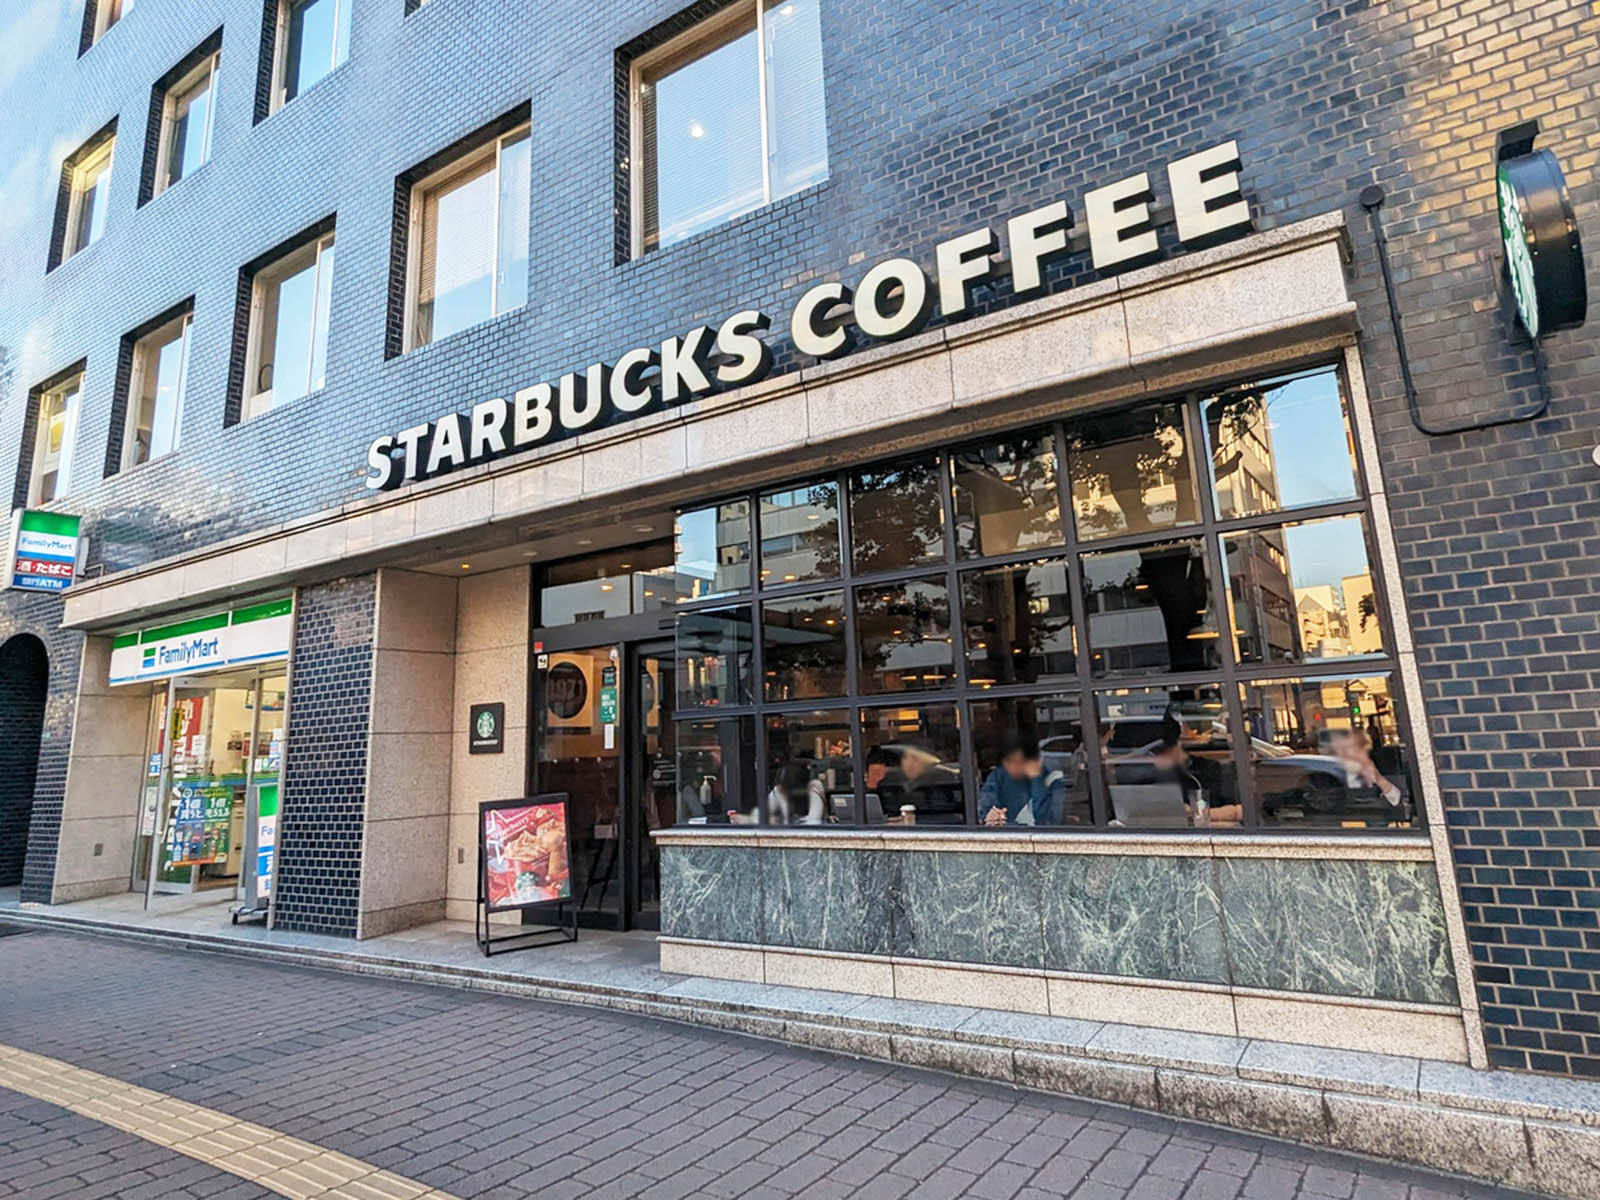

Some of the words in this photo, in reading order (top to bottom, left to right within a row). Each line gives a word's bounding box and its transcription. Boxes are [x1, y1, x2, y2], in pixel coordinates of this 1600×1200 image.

[365, 310, 763, 490] STARBUCKS
[790, 140, 1251, 357] COFFEE
[21, 536, 73, 550] FamilyMart
[158, 636, 219, 665] FamilyMart
